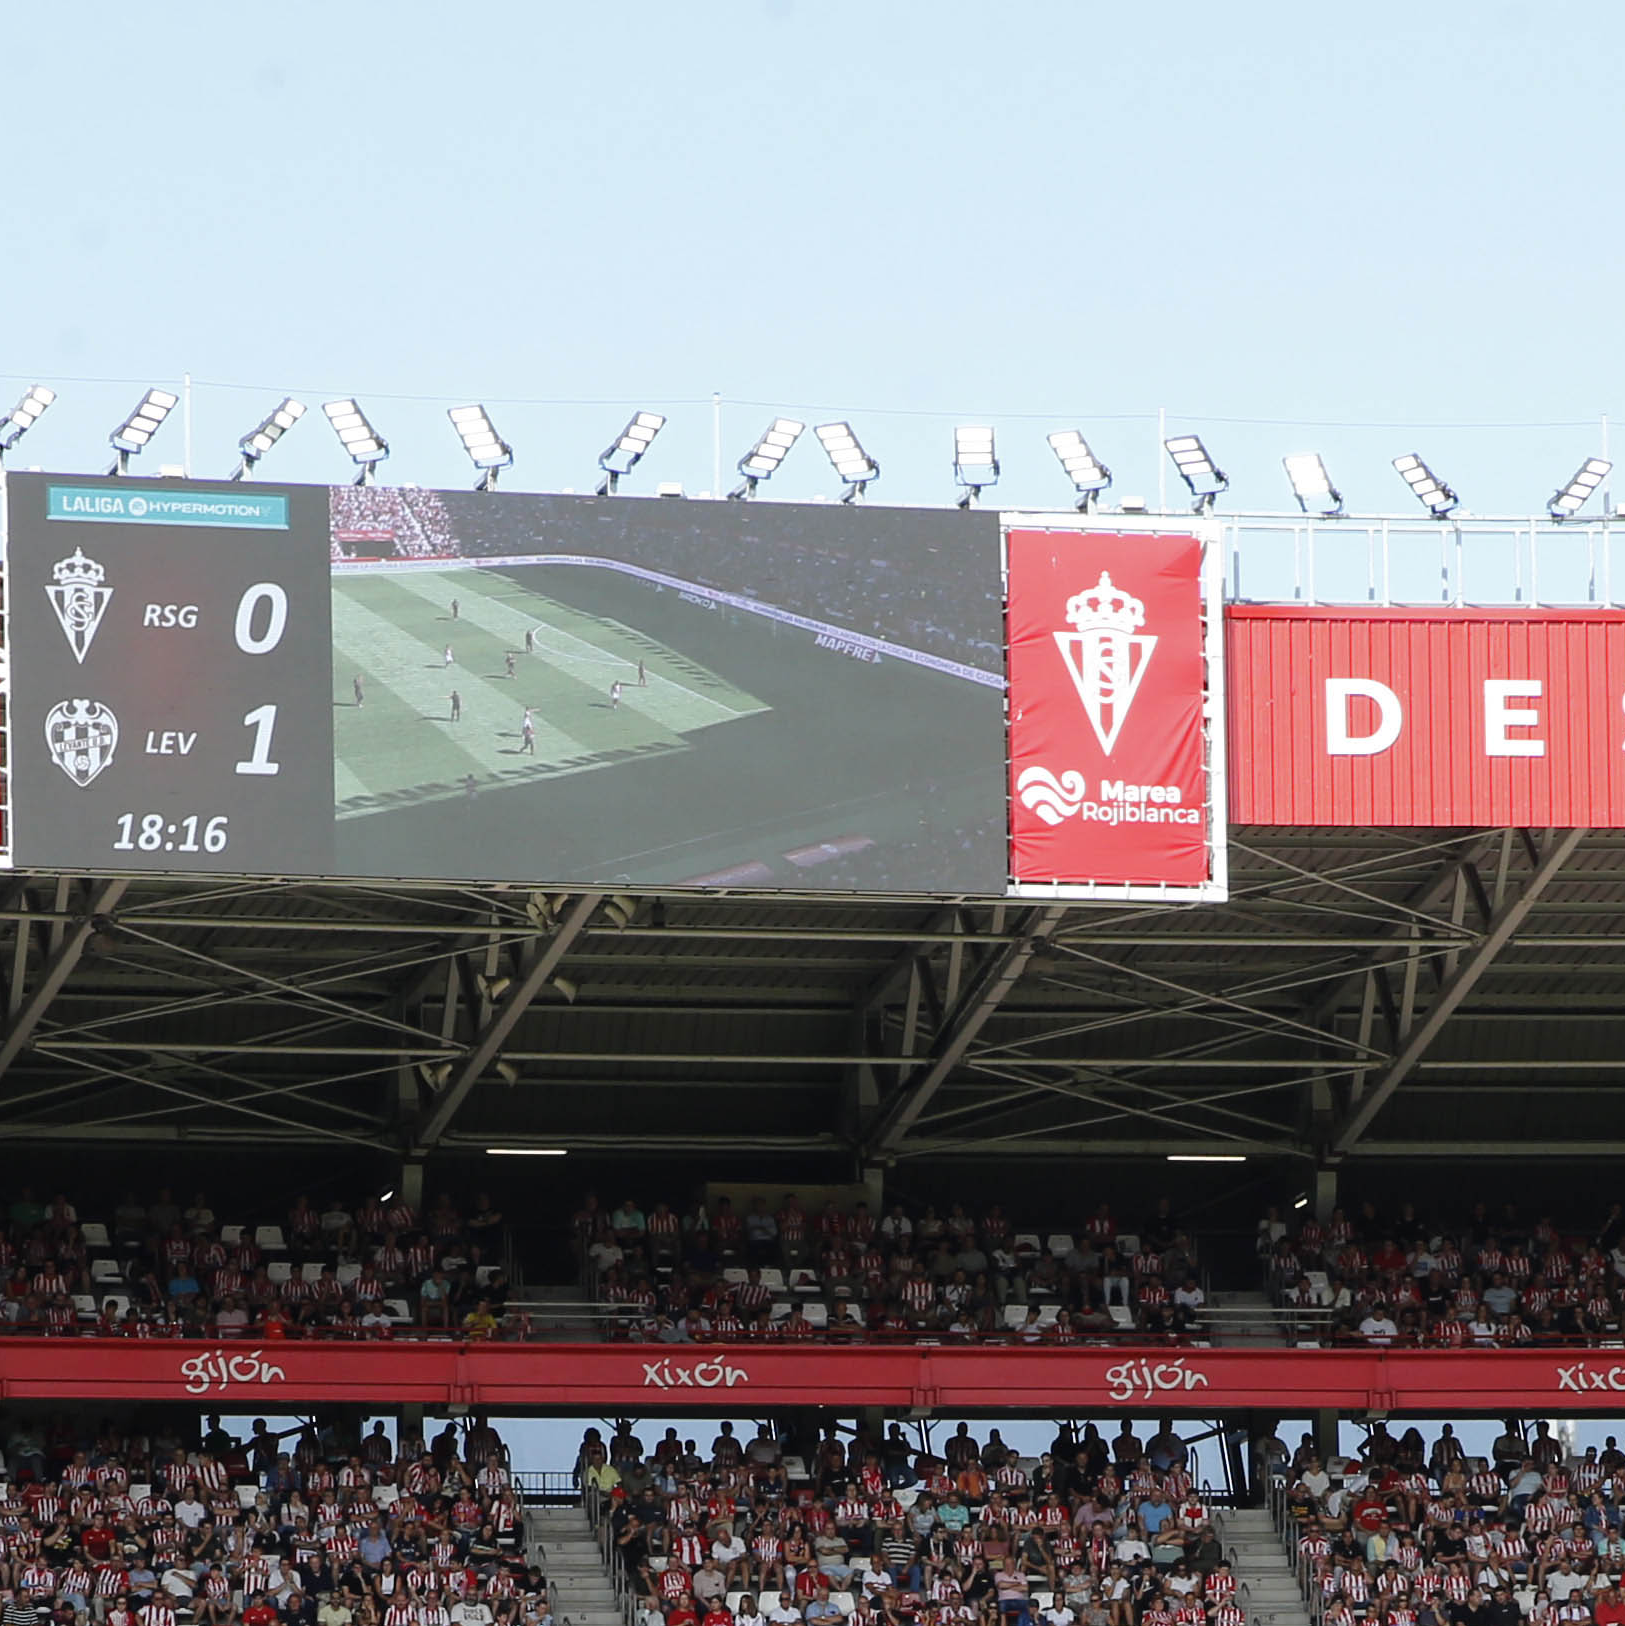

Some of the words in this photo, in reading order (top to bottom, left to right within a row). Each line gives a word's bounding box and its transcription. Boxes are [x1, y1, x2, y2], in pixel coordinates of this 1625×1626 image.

[62, 495, 125, 513] LALIGA
[149, 501, 260, 517] HYPERMOTION
[144, 605, 198, 627] RSG
[236, 583, 287, 653] 0
[814, 633, 872, 662] MAPFRE
[146, 732, 196, 754] LEV
[236, 705, 278, 774] 1
[1101, 779, 1181, 804] Marea
[1083, 802, 1199, 825] Rojiblanca
[114, 814, 227, 852] 18:16
